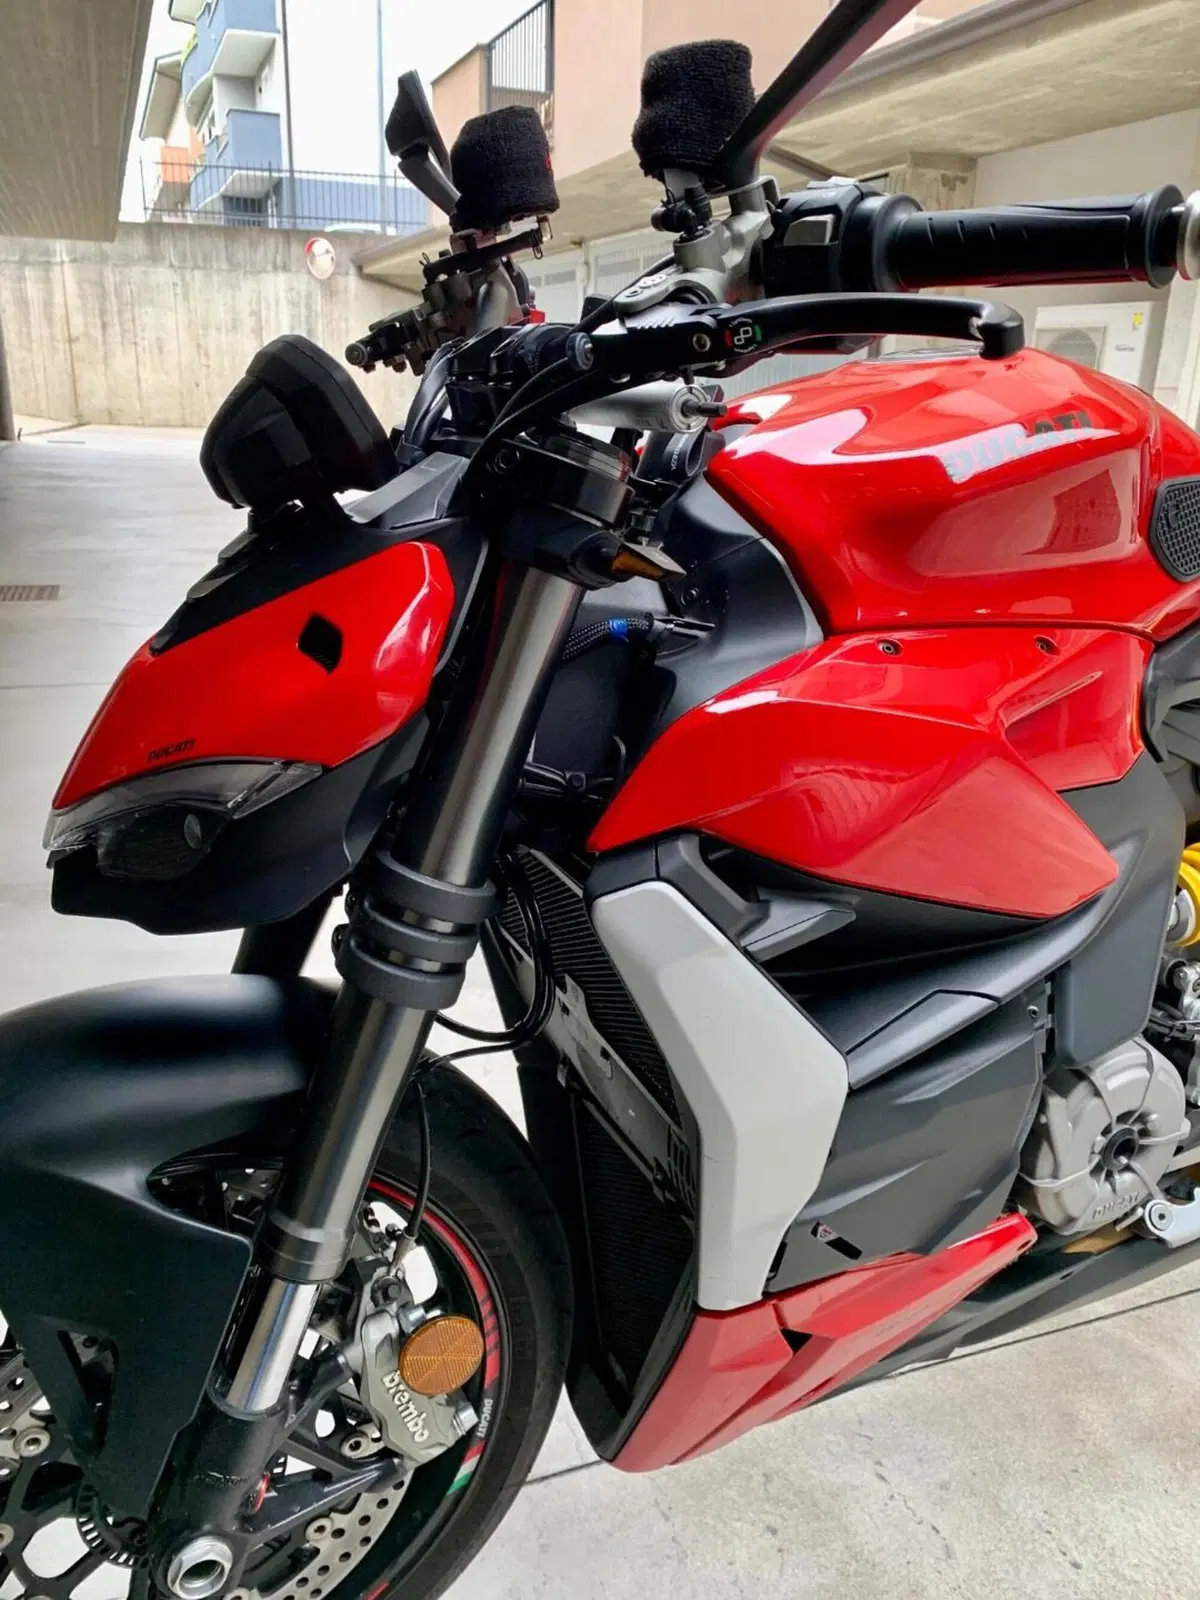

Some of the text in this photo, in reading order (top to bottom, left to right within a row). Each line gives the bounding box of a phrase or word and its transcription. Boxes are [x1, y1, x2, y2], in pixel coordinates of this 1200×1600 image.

[944, 410, 1093, 482] DUCATI
[382, 1370, 430, 1443] brembo
[476, 1398, 493, 1438] DUCATI
